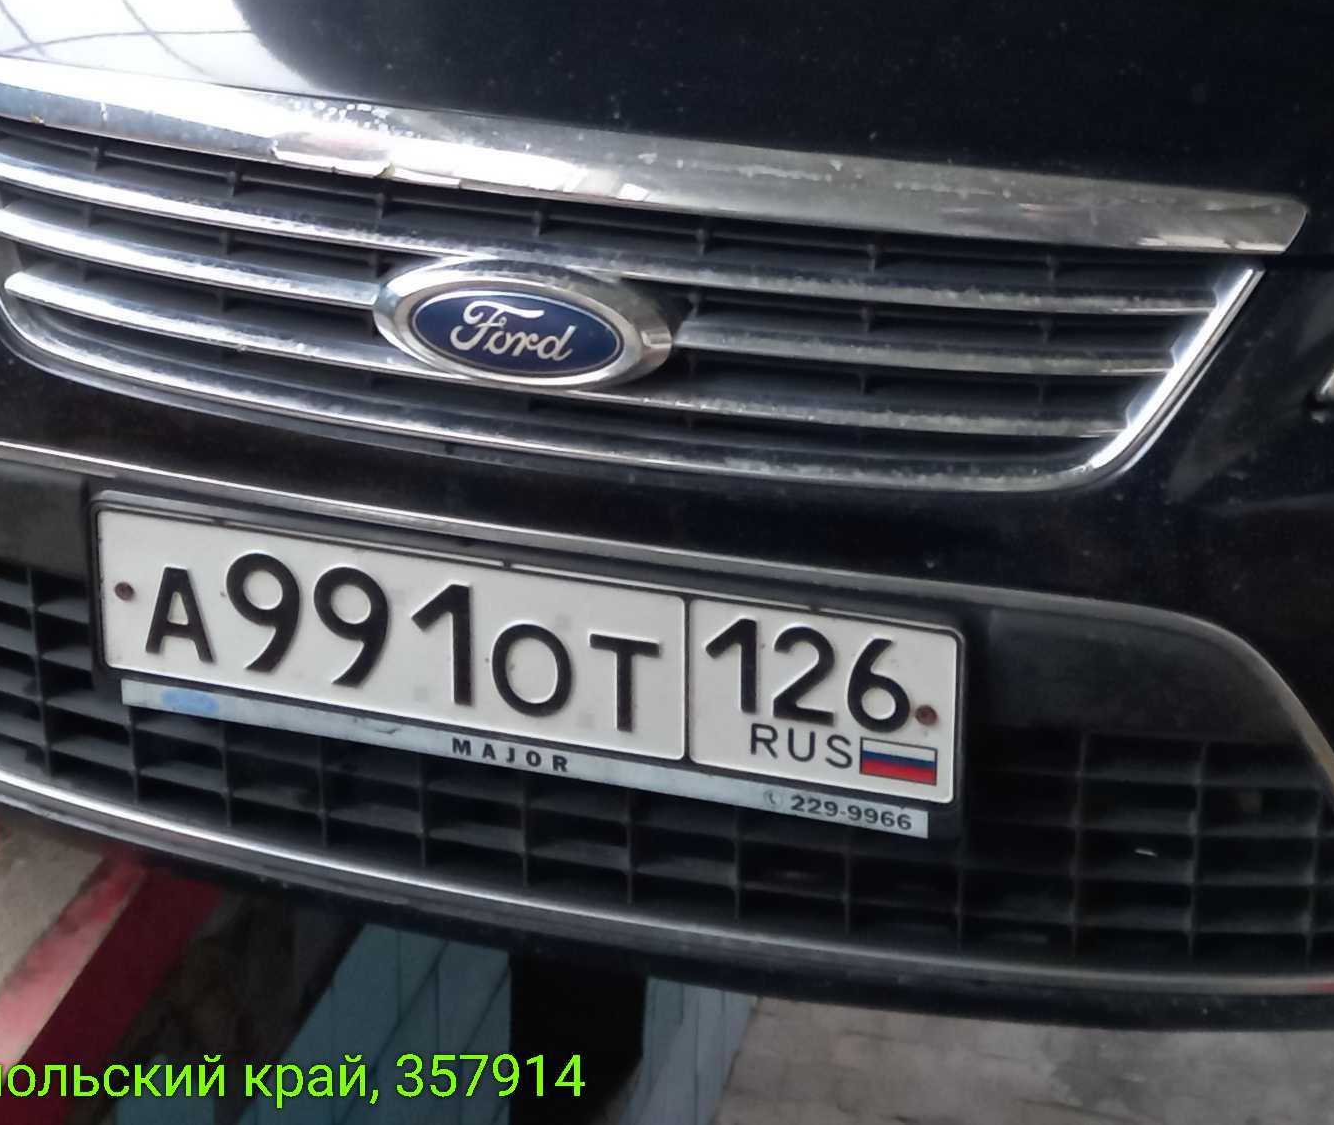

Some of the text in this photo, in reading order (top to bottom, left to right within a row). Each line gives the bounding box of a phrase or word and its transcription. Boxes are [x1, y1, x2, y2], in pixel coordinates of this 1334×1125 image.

[450, 300, 576, 362] Ford
[705, 617, 913, 735] 126
[451, 737, 569, 773] MAJOR
[750, 722, 855, 770] RUS
[790, 793, 914, 831] 229-9966
